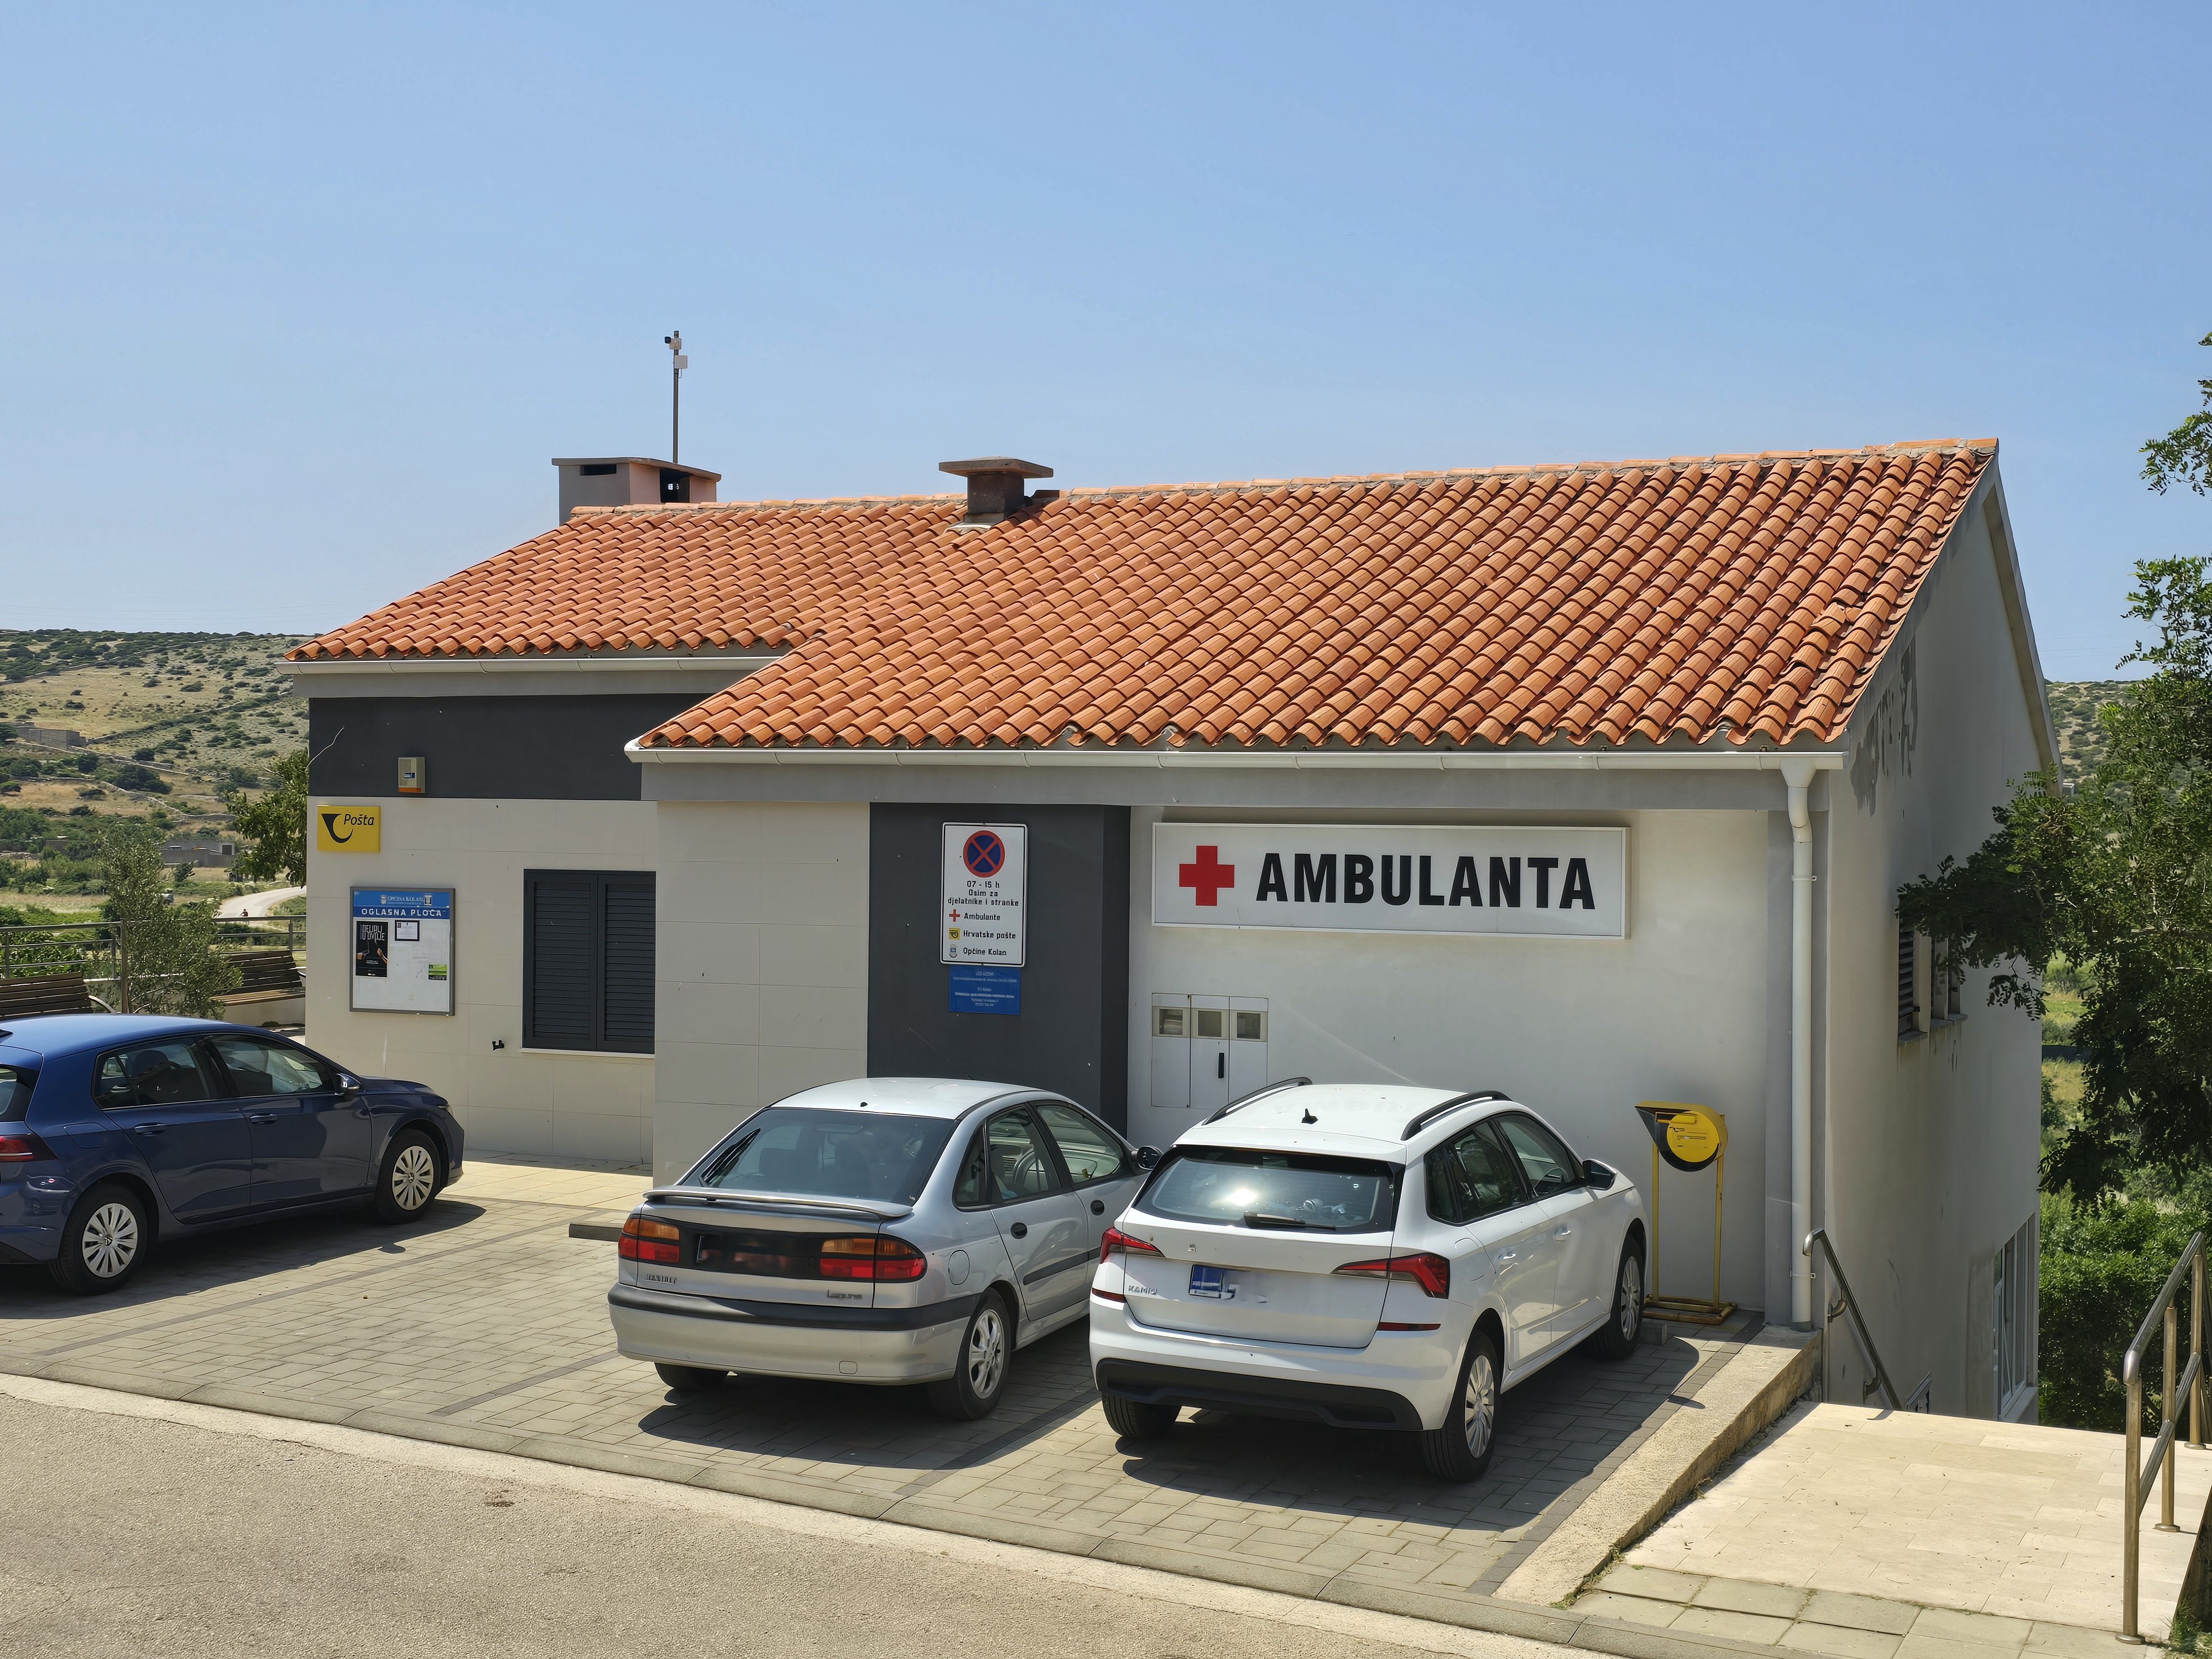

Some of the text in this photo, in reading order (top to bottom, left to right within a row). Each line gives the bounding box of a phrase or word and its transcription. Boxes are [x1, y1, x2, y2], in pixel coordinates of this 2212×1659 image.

[344, 813, 374, 826] Pošta
[1255, 853, 1596, 910] AMBULANTA
[947, 897, 982, 906] djelatnike
